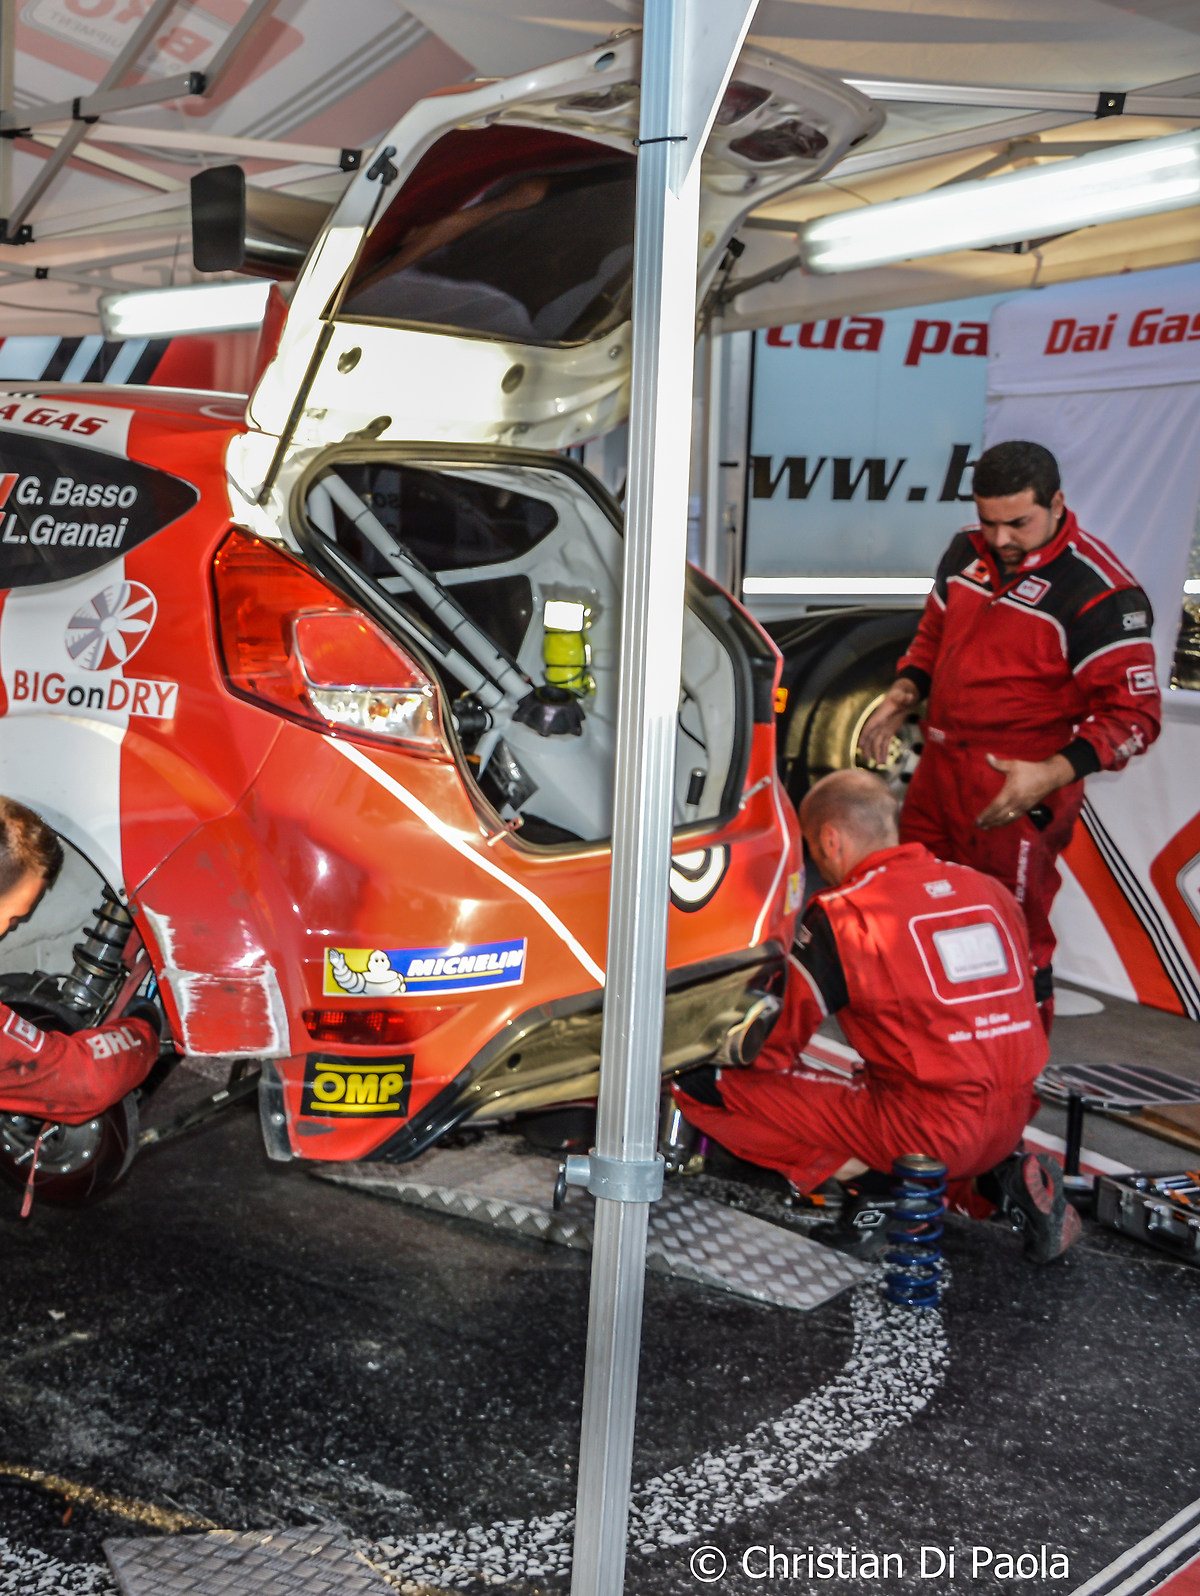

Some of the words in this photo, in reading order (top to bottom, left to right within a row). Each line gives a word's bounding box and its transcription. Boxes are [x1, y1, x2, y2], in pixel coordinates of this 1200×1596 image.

[1043, 312, 1118, 356] Dai
[22, 408, 109, 436] GAS
[16, 475, 44, 506] G.
[49, 476, 138, 508] Basso
[406, 949, 525, 977] MICHELIN
[312, 1071, 404, 1104] OMP
